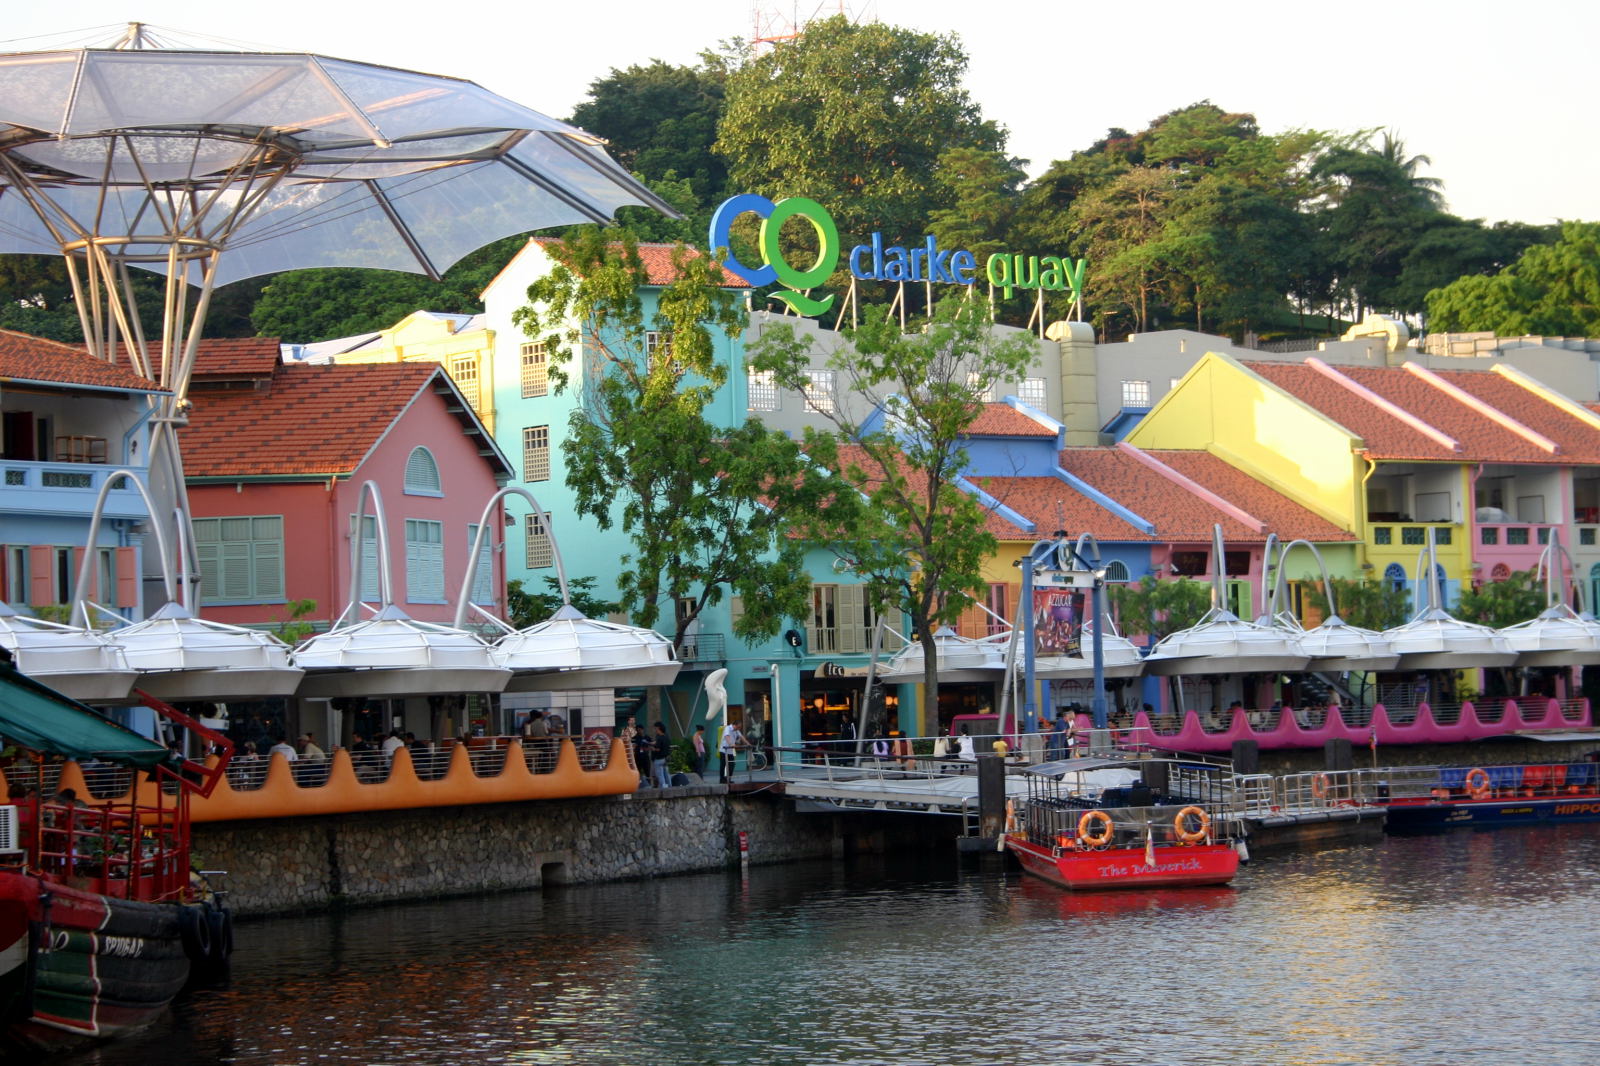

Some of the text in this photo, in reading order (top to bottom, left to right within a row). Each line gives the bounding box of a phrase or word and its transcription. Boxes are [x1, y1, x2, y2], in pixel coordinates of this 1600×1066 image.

[709, 193, 840, 317] CQ
[850, 231, 1088, 304] clarke quay
[1098, 858, 1203, 877] The Maverick
